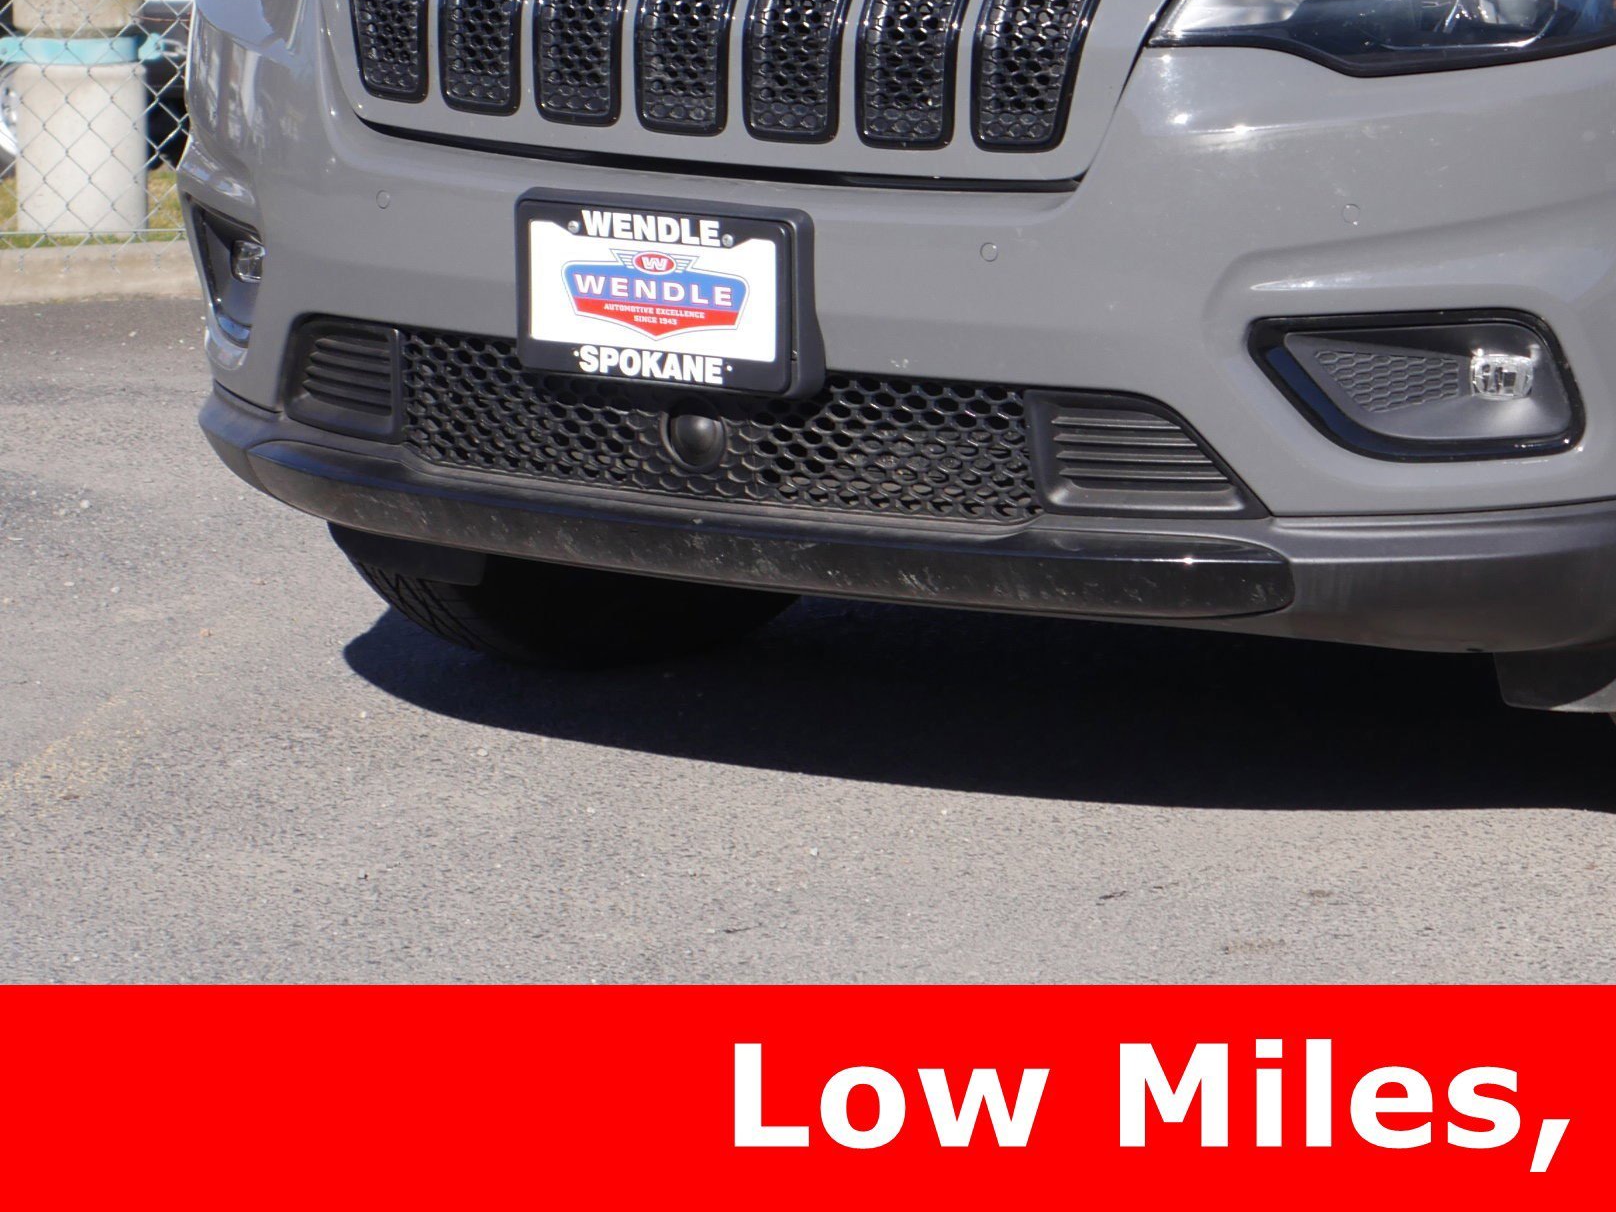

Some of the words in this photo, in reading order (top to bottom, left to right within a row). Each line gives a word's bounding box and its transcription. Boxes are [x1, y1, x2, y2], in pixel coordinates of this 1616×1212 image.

[581, 210, 722, 247] WENDLE
[641, 256, 669, 272] W
[573, 273, 733, 307] WENDLE
[603, 303, 654, 315] AUTOMOTIVE
[655, 307, 706, 320] EXCELLENCE
[633, 315, 658, 324] SINCE
[659, 316, 678, 326] 1943
[578, 344, 723, 385] SPOKANE
